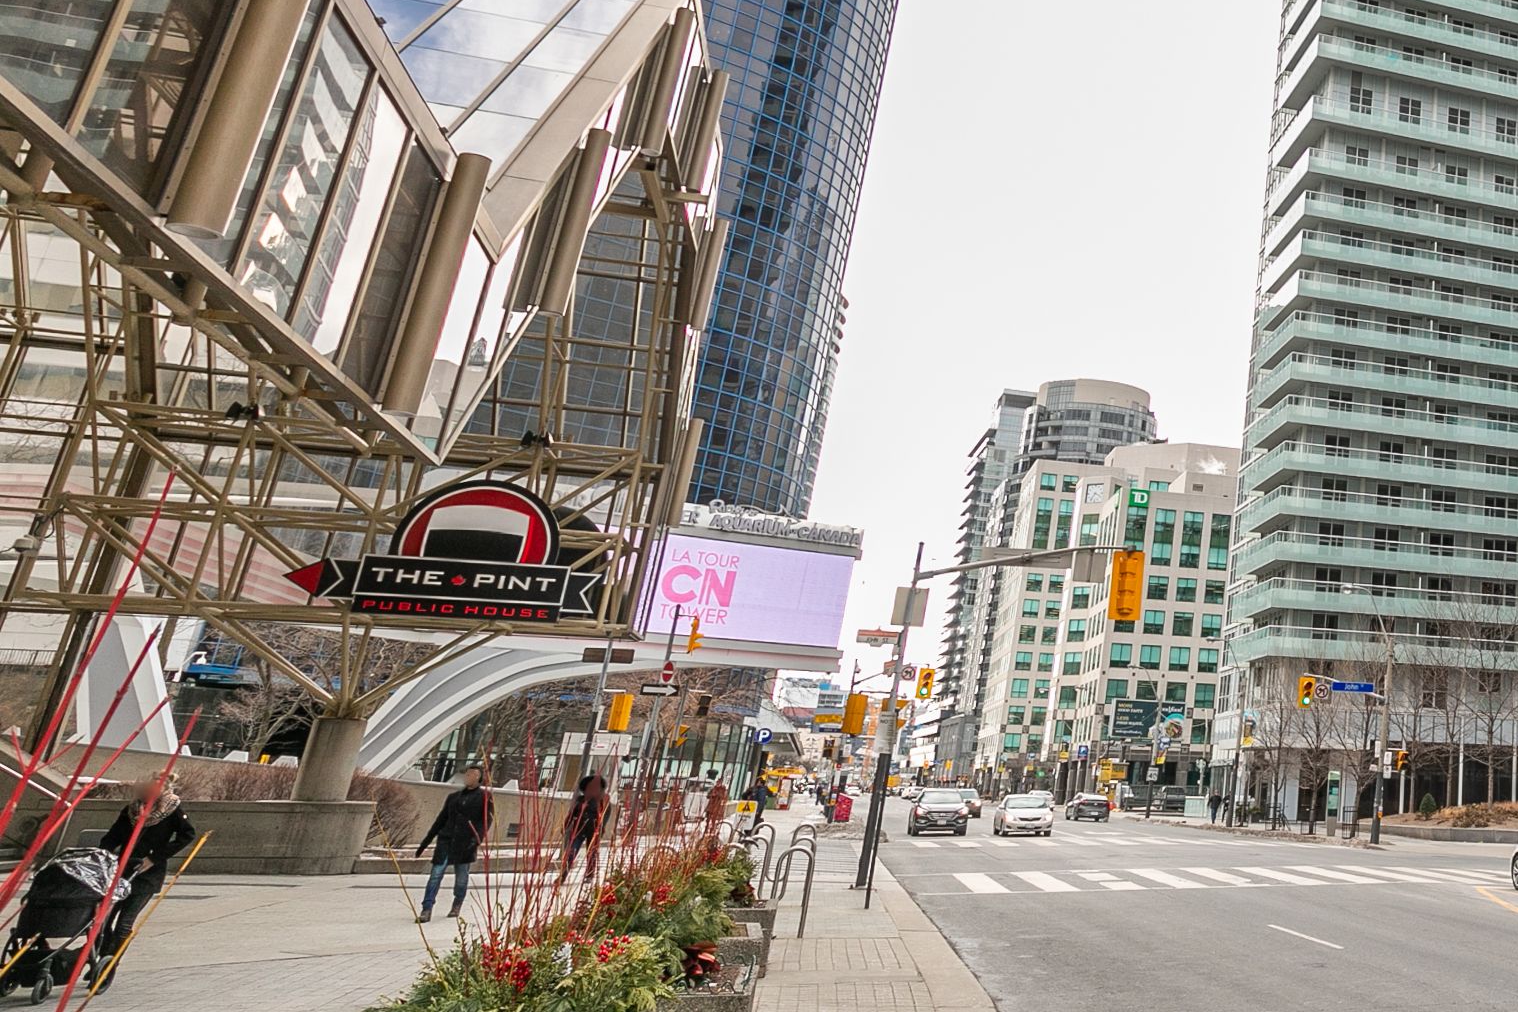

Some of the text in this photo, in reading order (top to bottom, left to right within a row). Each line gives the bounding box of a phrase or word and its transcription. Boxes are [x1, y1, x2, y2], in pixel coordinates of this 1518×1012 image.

[1132, 491, 1149, 504] TD
[709, 514, 791, 537] AQUARIUM
[797, 526, 862, 545] CANADA
[671, 548, 740, 569] LA TOUR
[371, 567, 557, 592] THE PINT
[661, 564, 738, 608] CN
[362, 600, 550, 619] PUBLIC HOUSE
[660, 603, 729, 625] TOWER
